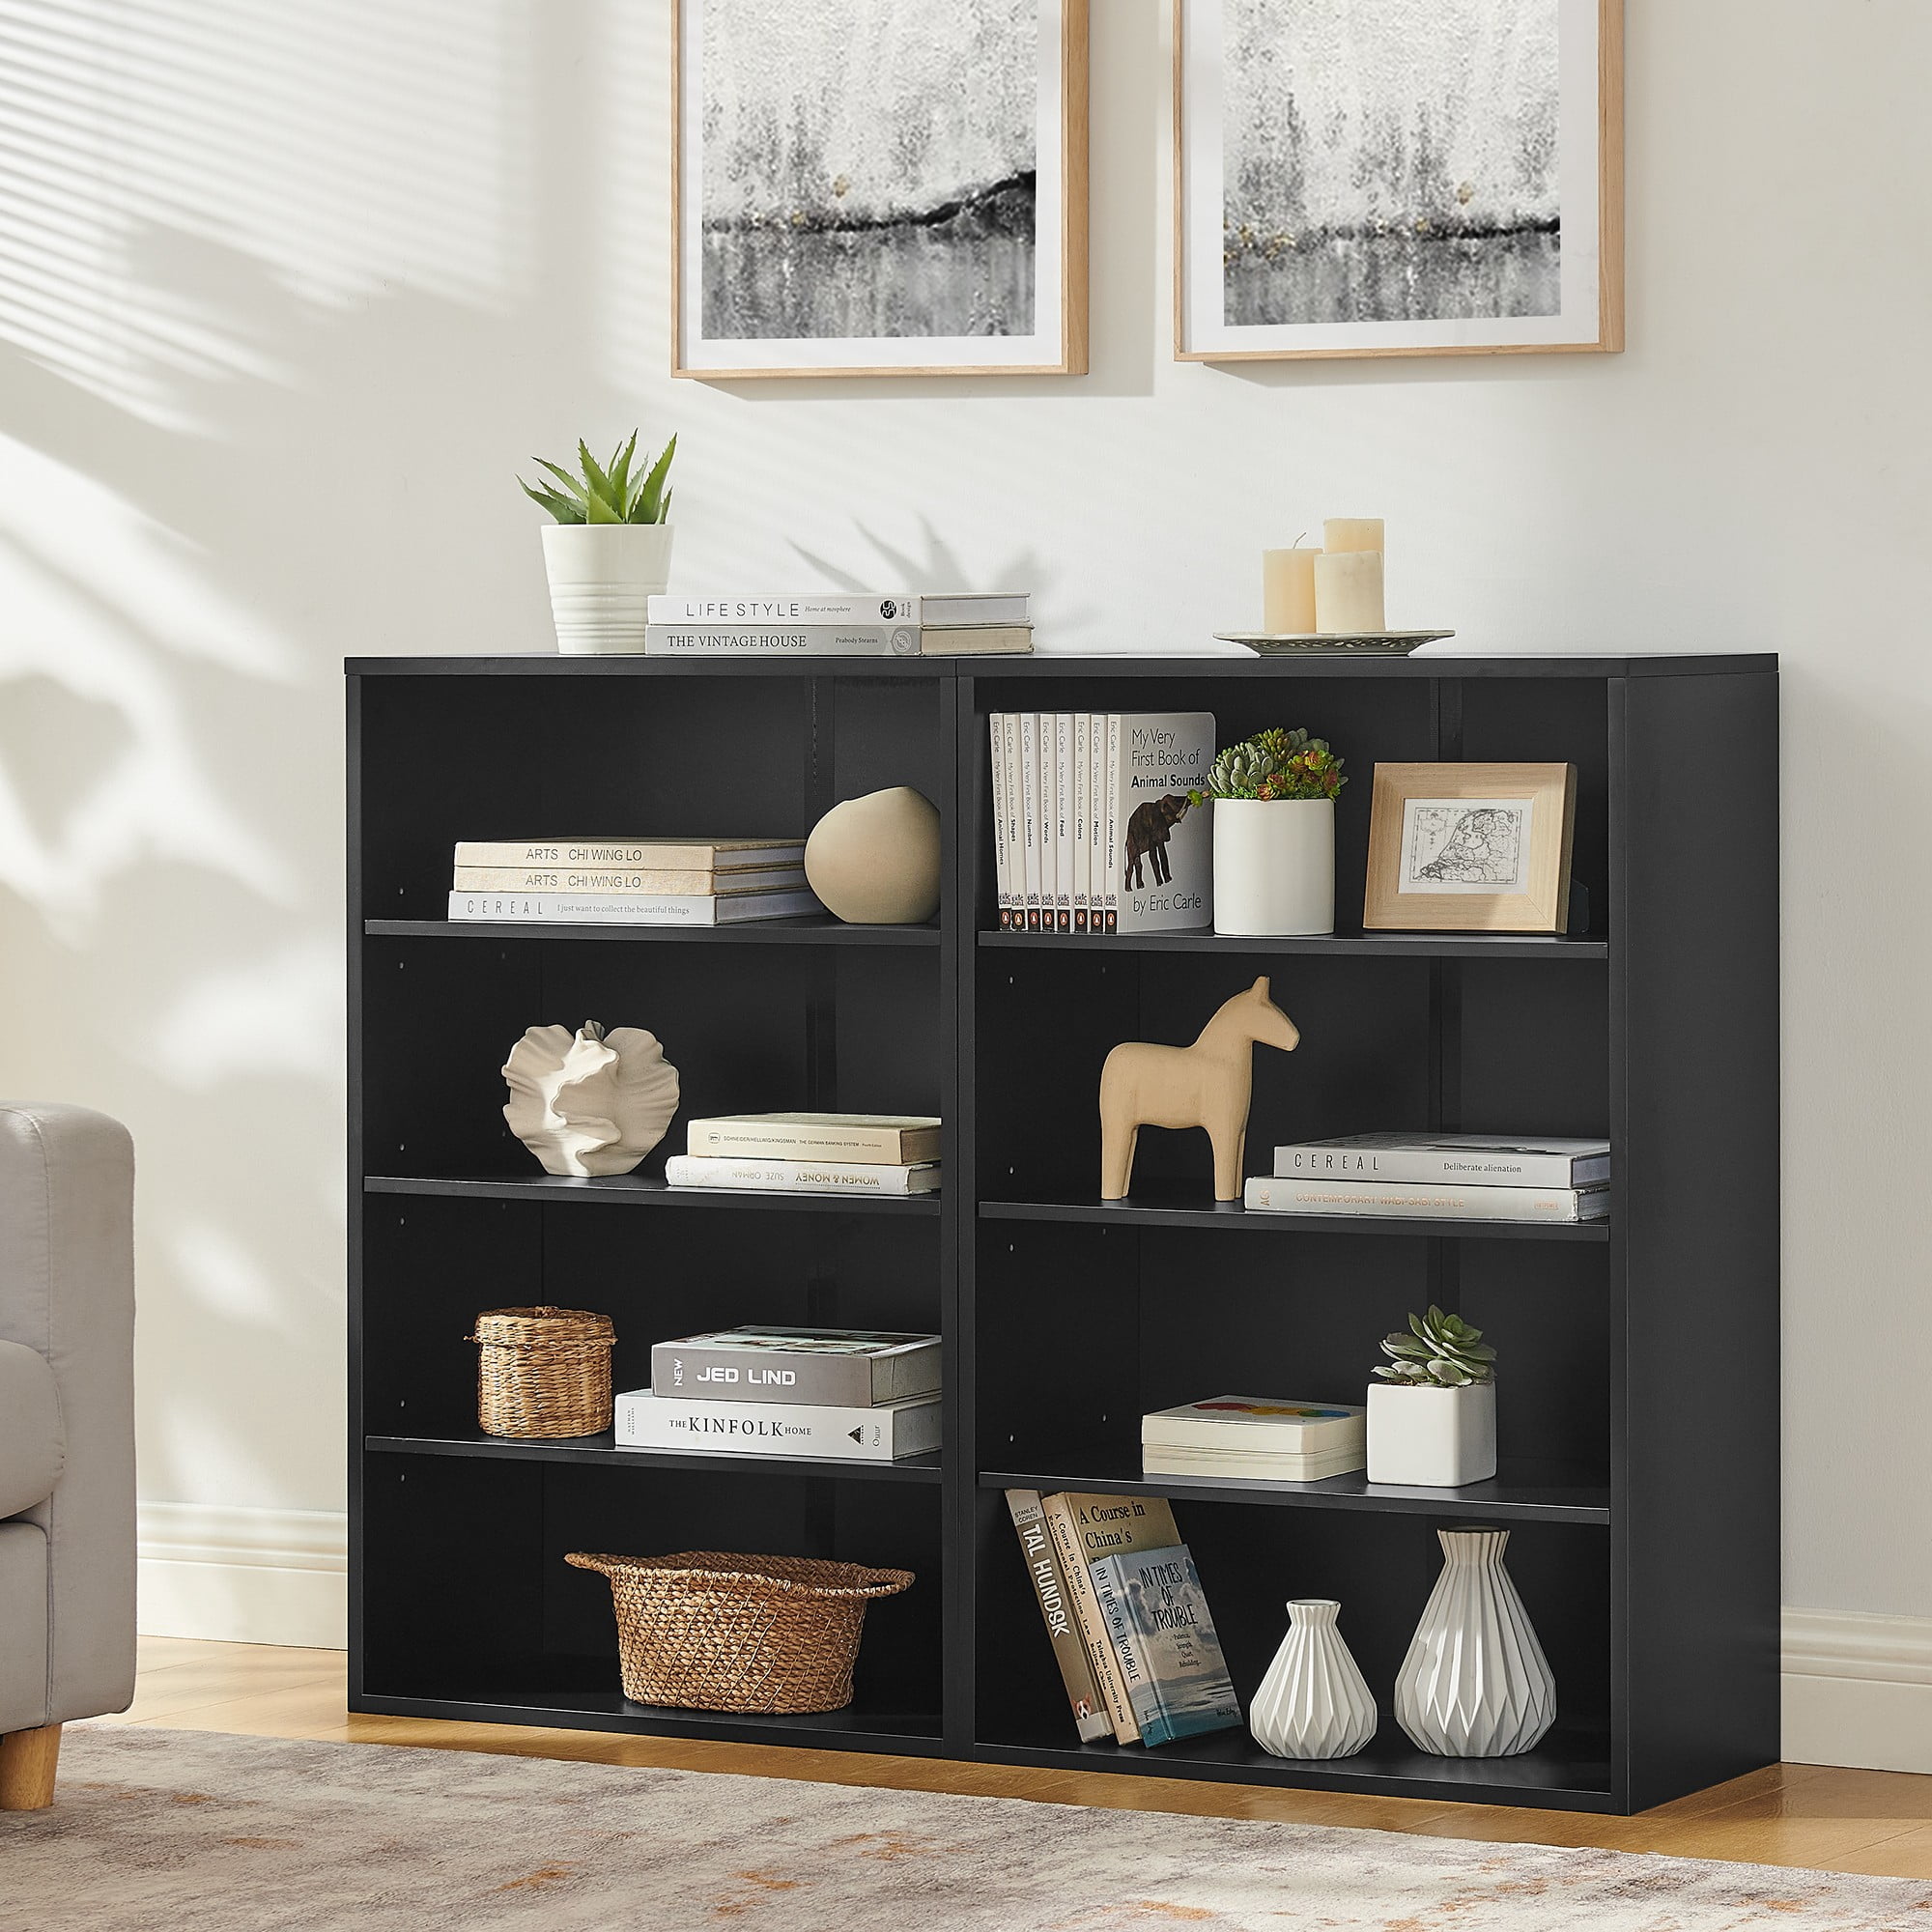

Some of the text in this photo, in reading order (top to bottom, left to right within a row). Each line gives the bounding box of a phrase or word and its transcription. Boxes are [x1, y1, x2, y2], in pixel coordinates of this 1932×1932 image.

[668, 635, 807, 647] THE VINTAGE HOUSE
[1131, 727, 1176, 749] My Very
[1131, 748, 1201, 767] First Book of
[1131, 774, 1206, 788] Animal Sounds
[526, 848, 642, 861] ARTS CHI WING LO
[526, 875, 641, 888] ARTS CHI WING LO
[467, 899, 543, 915] CEREAL
[637, 905, 668, 914] beautiful
[668, 906, 690, 916] things
[1133, 895, 1146, 914] by
[1150, 895, 1170, 911] Eric
[1173, 893, 1202, 910] Carle
[1294, 1153, 1379, 1171] CEREAL
[1443, 1162, 1521, 1174] Deliberate alienation
[731, 1170, 784, 1181] SUZE ORMAN
[795, 1173, 881, 1185] WOMEN & MONEY
[1295, 1192, 1377, 1205] CONTEMPORARY
[1434, 1197, 1464, 1208] STYLE
[674, 1358, 683, 1386] NEW
[696, 1367, 796, 1386] JED LIND
[669, 1416, 812, 1436] THE KINFOLK HOME
[1014, 1506, 1038, 1519] STANLEY
[1018, 1513, 1038, 1523] COREN
[1079, 1502, 1146, 1525] A Course in
[1085, 1529, 1133, 1549] China's
[1048, 1515, 1070, 1572] Environmental
[1067, 1575, 1084, 1615] Protection
[1059, 1522, 1071, 1549] Course
[1068, 1553, 1075, 1562] in
[1072, 1565, 1086, 1596] China's
[1022, 1523, 1070, 1638] TAL HUNDSK
[1094, 1566, 1108, 1581] IN
[1138, 1562, 1183, 1589] IN TIMES
[1100, 1581, 1120, 1615] TIMES
[1161, 1585, 1175, 1606] OF
[1112, 1616, 1125, 1631] OF
[1151, 1604, 1199, 1633] TROUBLE
[1116, 1631, 1141, 1684] TROUBLE
[1095, 1639, 1124, 1723] Tsinghua University Press
